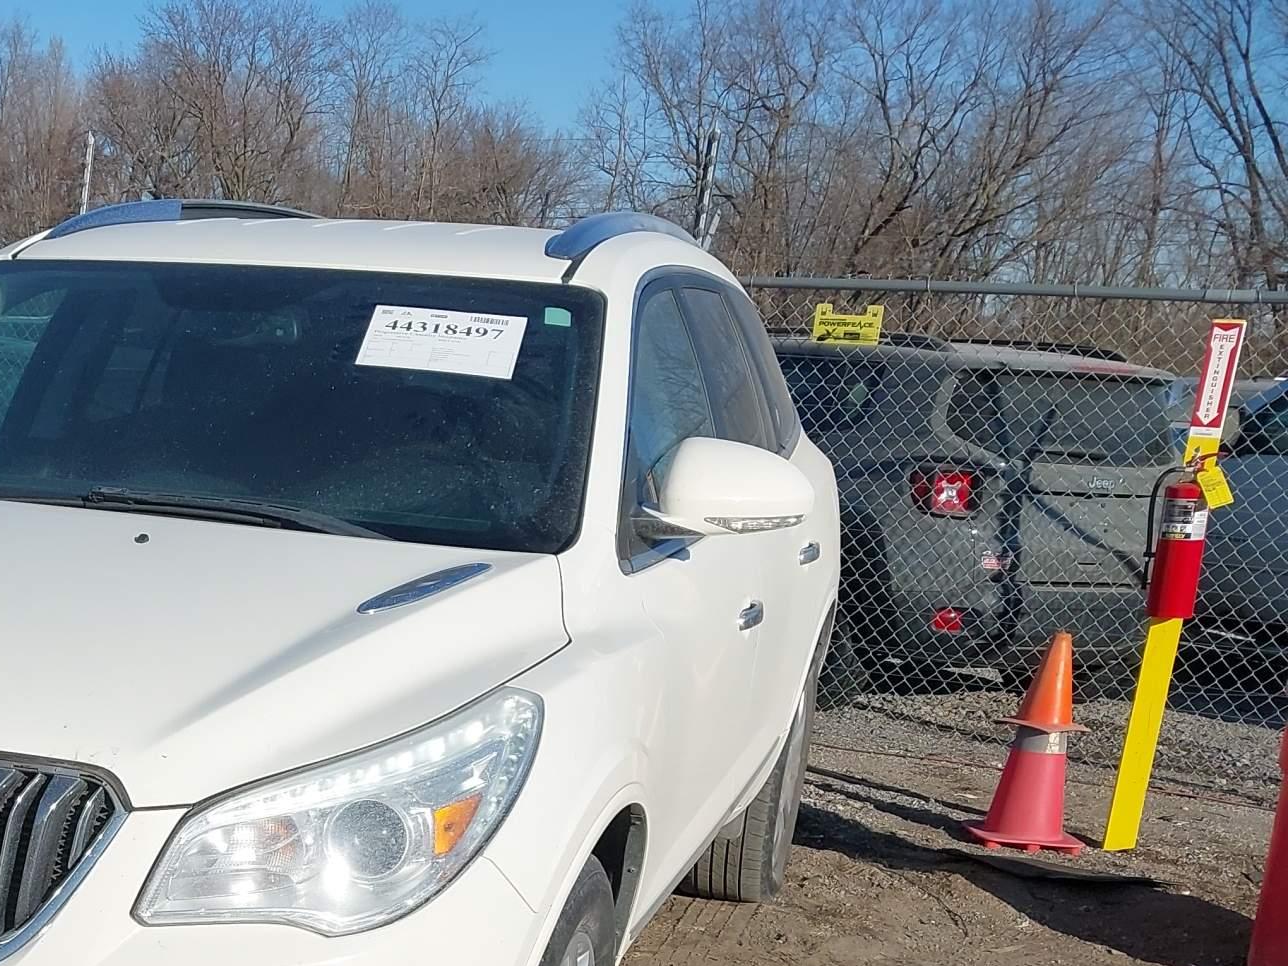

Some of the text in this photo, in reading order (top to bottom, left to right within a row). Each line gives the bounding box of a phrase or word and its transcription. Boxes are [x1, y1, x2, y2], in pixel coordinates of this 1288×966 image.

[385, 319, 505, 340] 44318497
[1213, 333, 1237, 343] FIRE
[1203, 344, 1224, 419] EXTINGUISHER
[1089, 477, 1115, 490] Jeep
